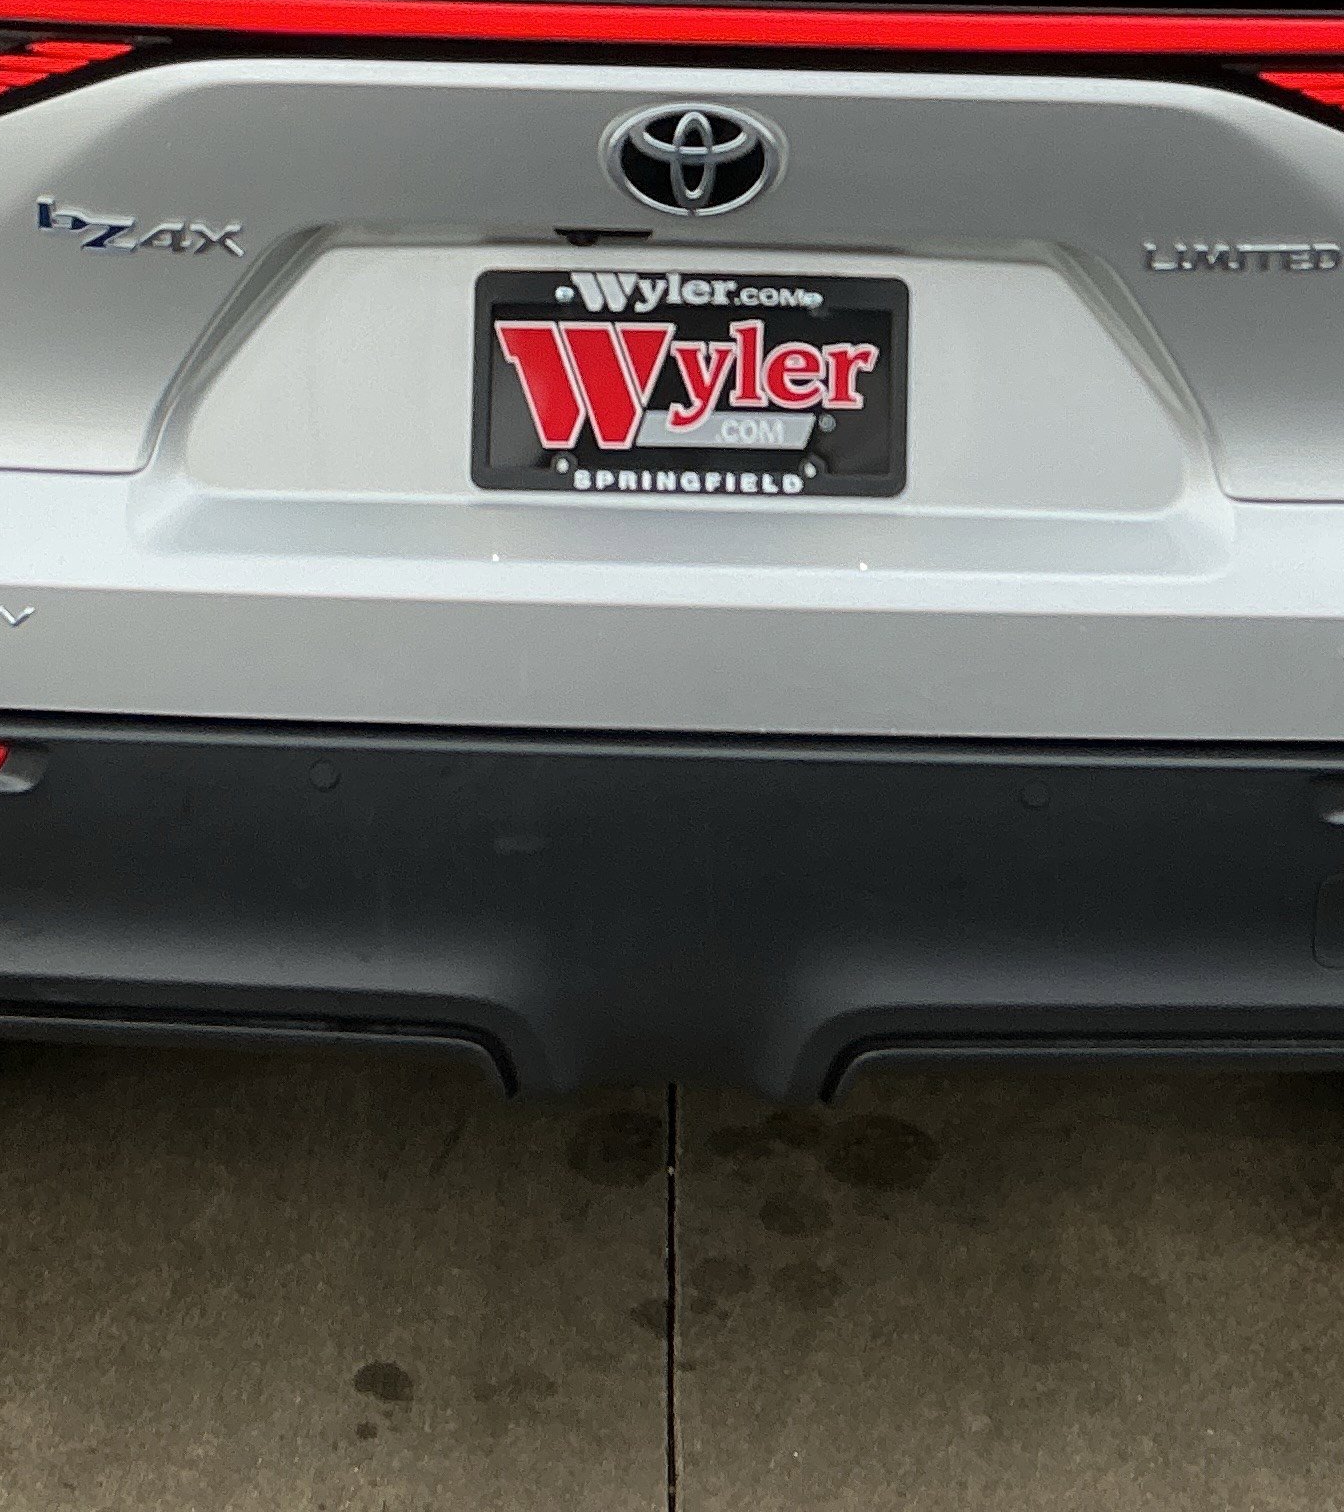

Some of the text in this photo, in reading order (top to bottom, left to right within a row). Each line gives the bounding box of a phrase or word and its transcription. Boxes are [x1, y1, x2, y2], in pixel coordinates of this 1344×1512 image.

[1143, 242, 1342, 272] LIMITED
[494, 318, 879, 450] Wyler
[573, 468, 805, 494] SPRINGFIELD
